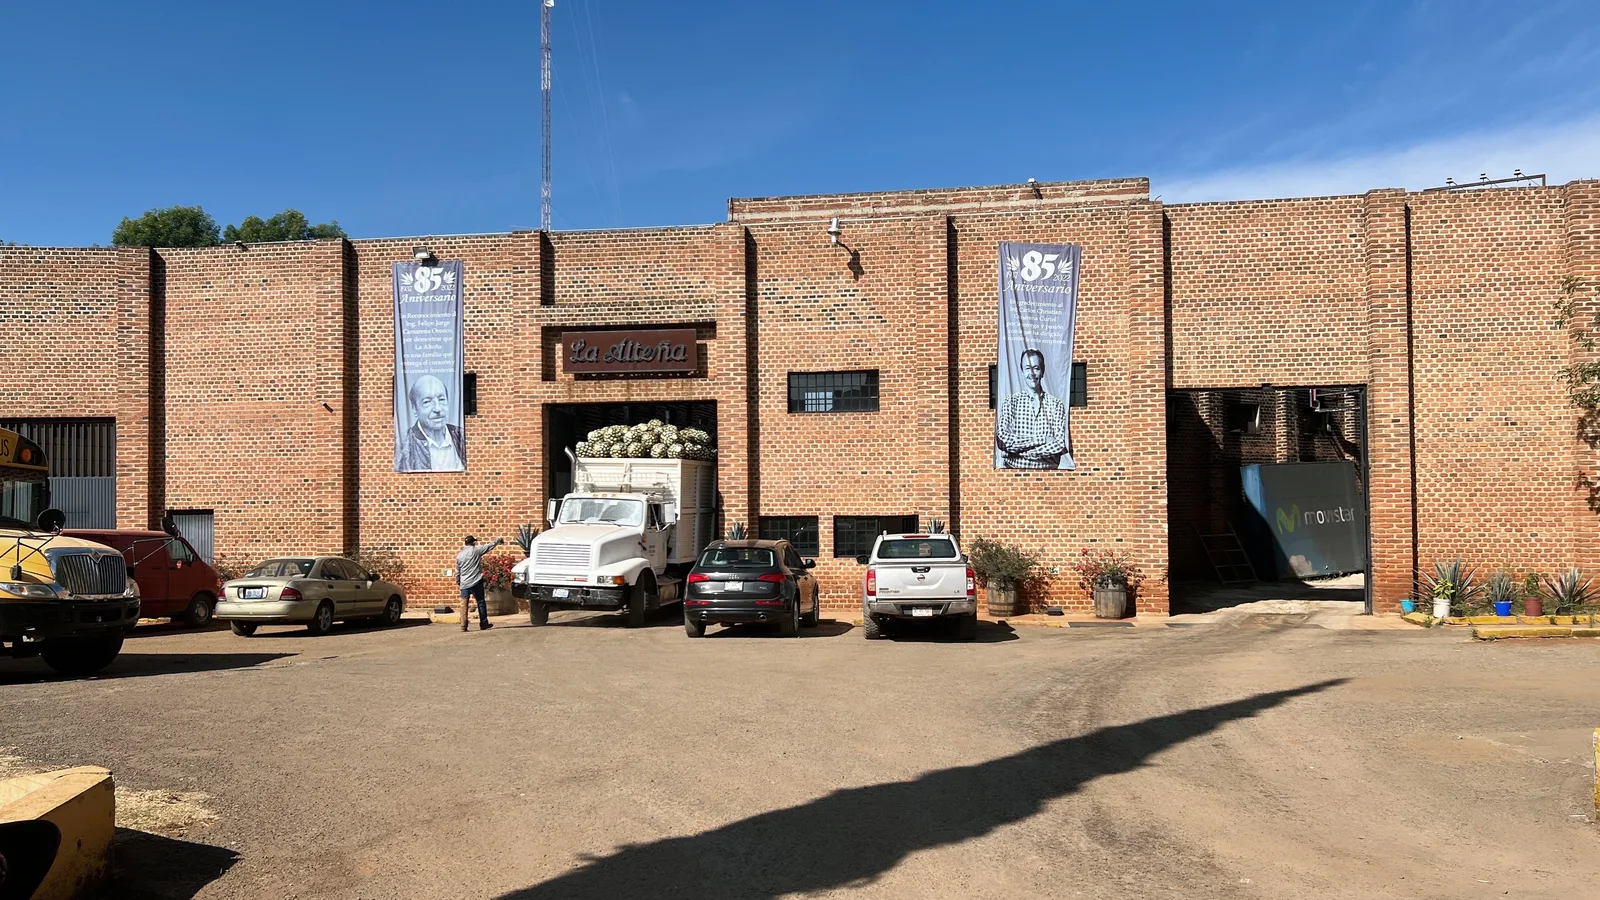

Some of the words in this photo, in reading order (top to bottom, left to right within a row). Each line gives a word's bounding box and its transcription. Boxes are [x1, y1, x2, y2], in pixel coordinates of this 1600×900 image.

[1021, 250, 1059, 282] 85
[414, 266, 444, 294] 85
[1003, 280, 1072, 294] Aniversario
[1053, 274, 1070, 282] 2022
[400, 291, 456, 304] Aniversario
[570, 338, 599, 362] La
[604, 338, 688, 364] Alteña
[1304, 507, 1354, 526] movistar
